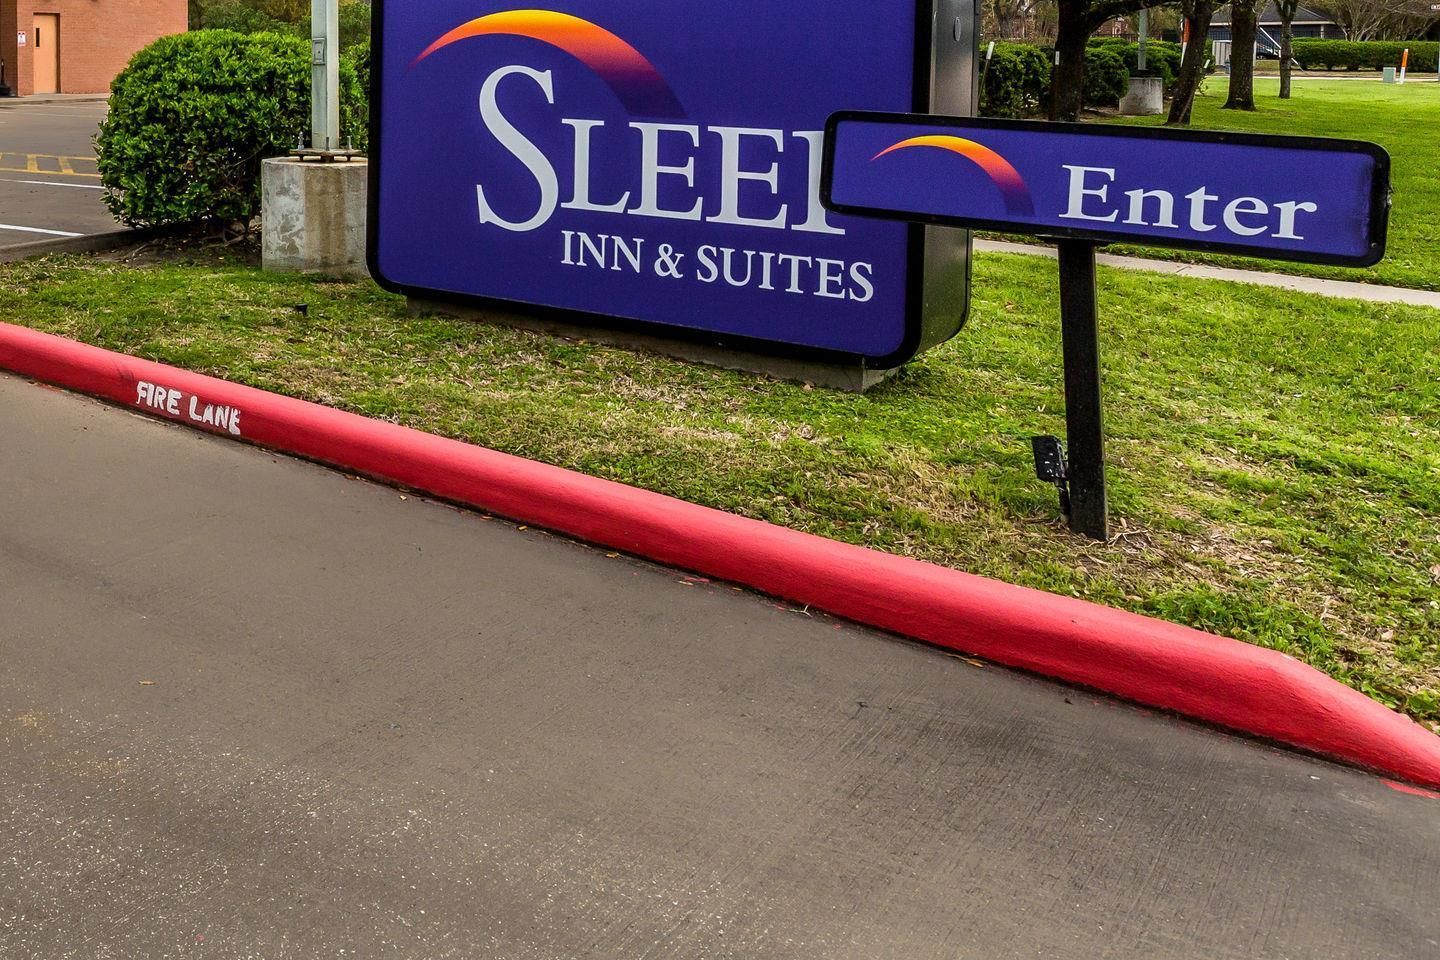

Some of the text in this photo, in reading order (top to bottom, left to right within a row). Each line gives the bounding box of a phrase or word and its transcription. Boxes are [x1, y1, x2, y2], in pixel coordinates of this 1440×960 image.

[1058, 164, 1319, 241] Enter
[560, 230, 875, 303] INN & SUITES
[136, 381, 241, 435] FIRE LANE
